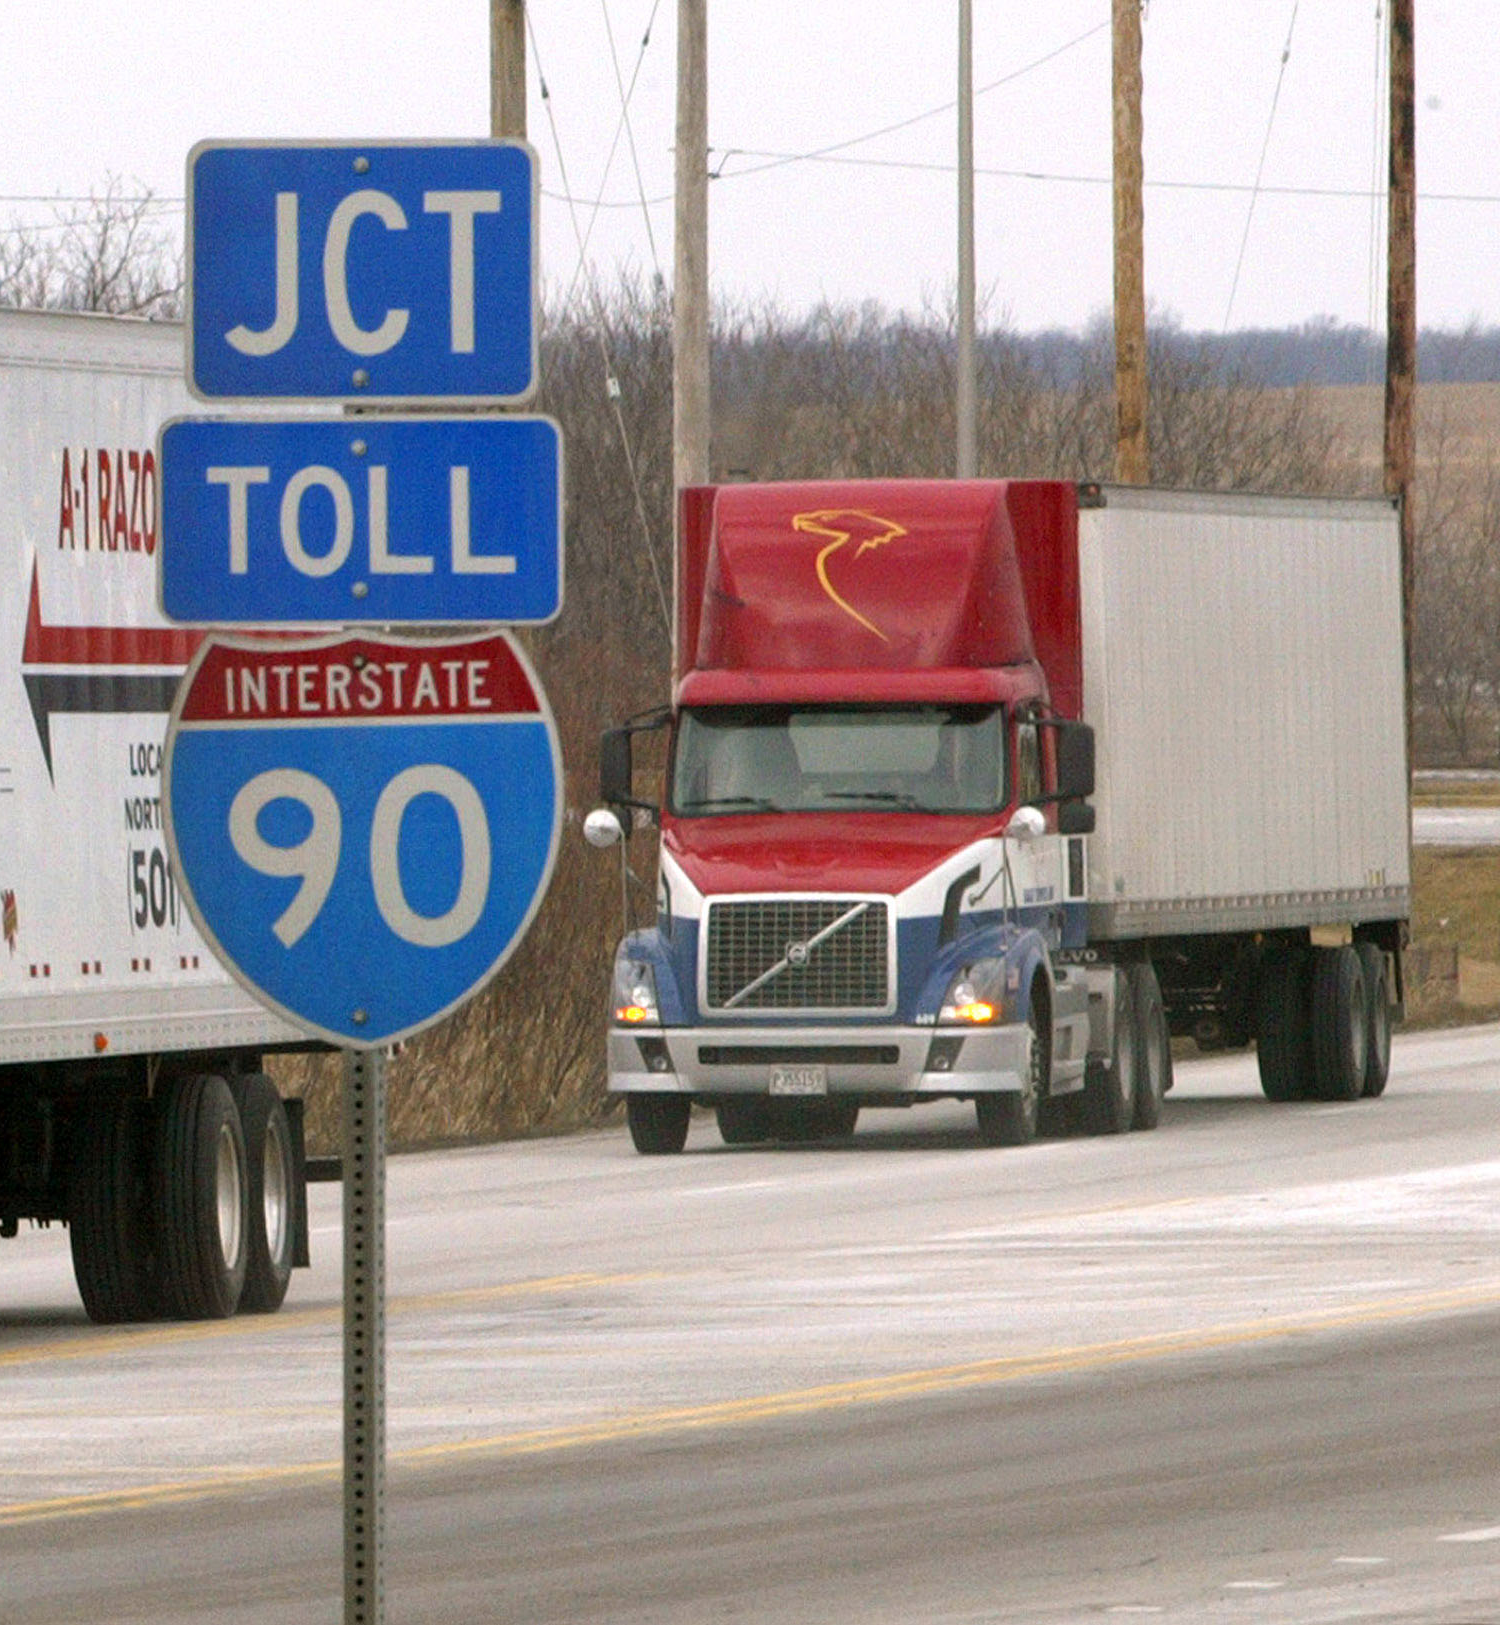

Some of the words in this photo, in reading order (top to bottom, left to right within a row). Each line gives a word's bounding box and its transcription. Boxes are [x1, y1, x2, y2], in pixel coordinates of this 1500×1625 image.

[224, 189, 501, 356] JCT
[58, 446, 90, 552] A-1
[98, 448, 157, 555] RAZO
[206, 465, 517, 577] TOLL
[225, 660, 492, 714] INTERSTATE
[125, 797, 164, 831] NORT
[129, 743, 164, 776] LOCA
[228, 764, 491, 950] 90
